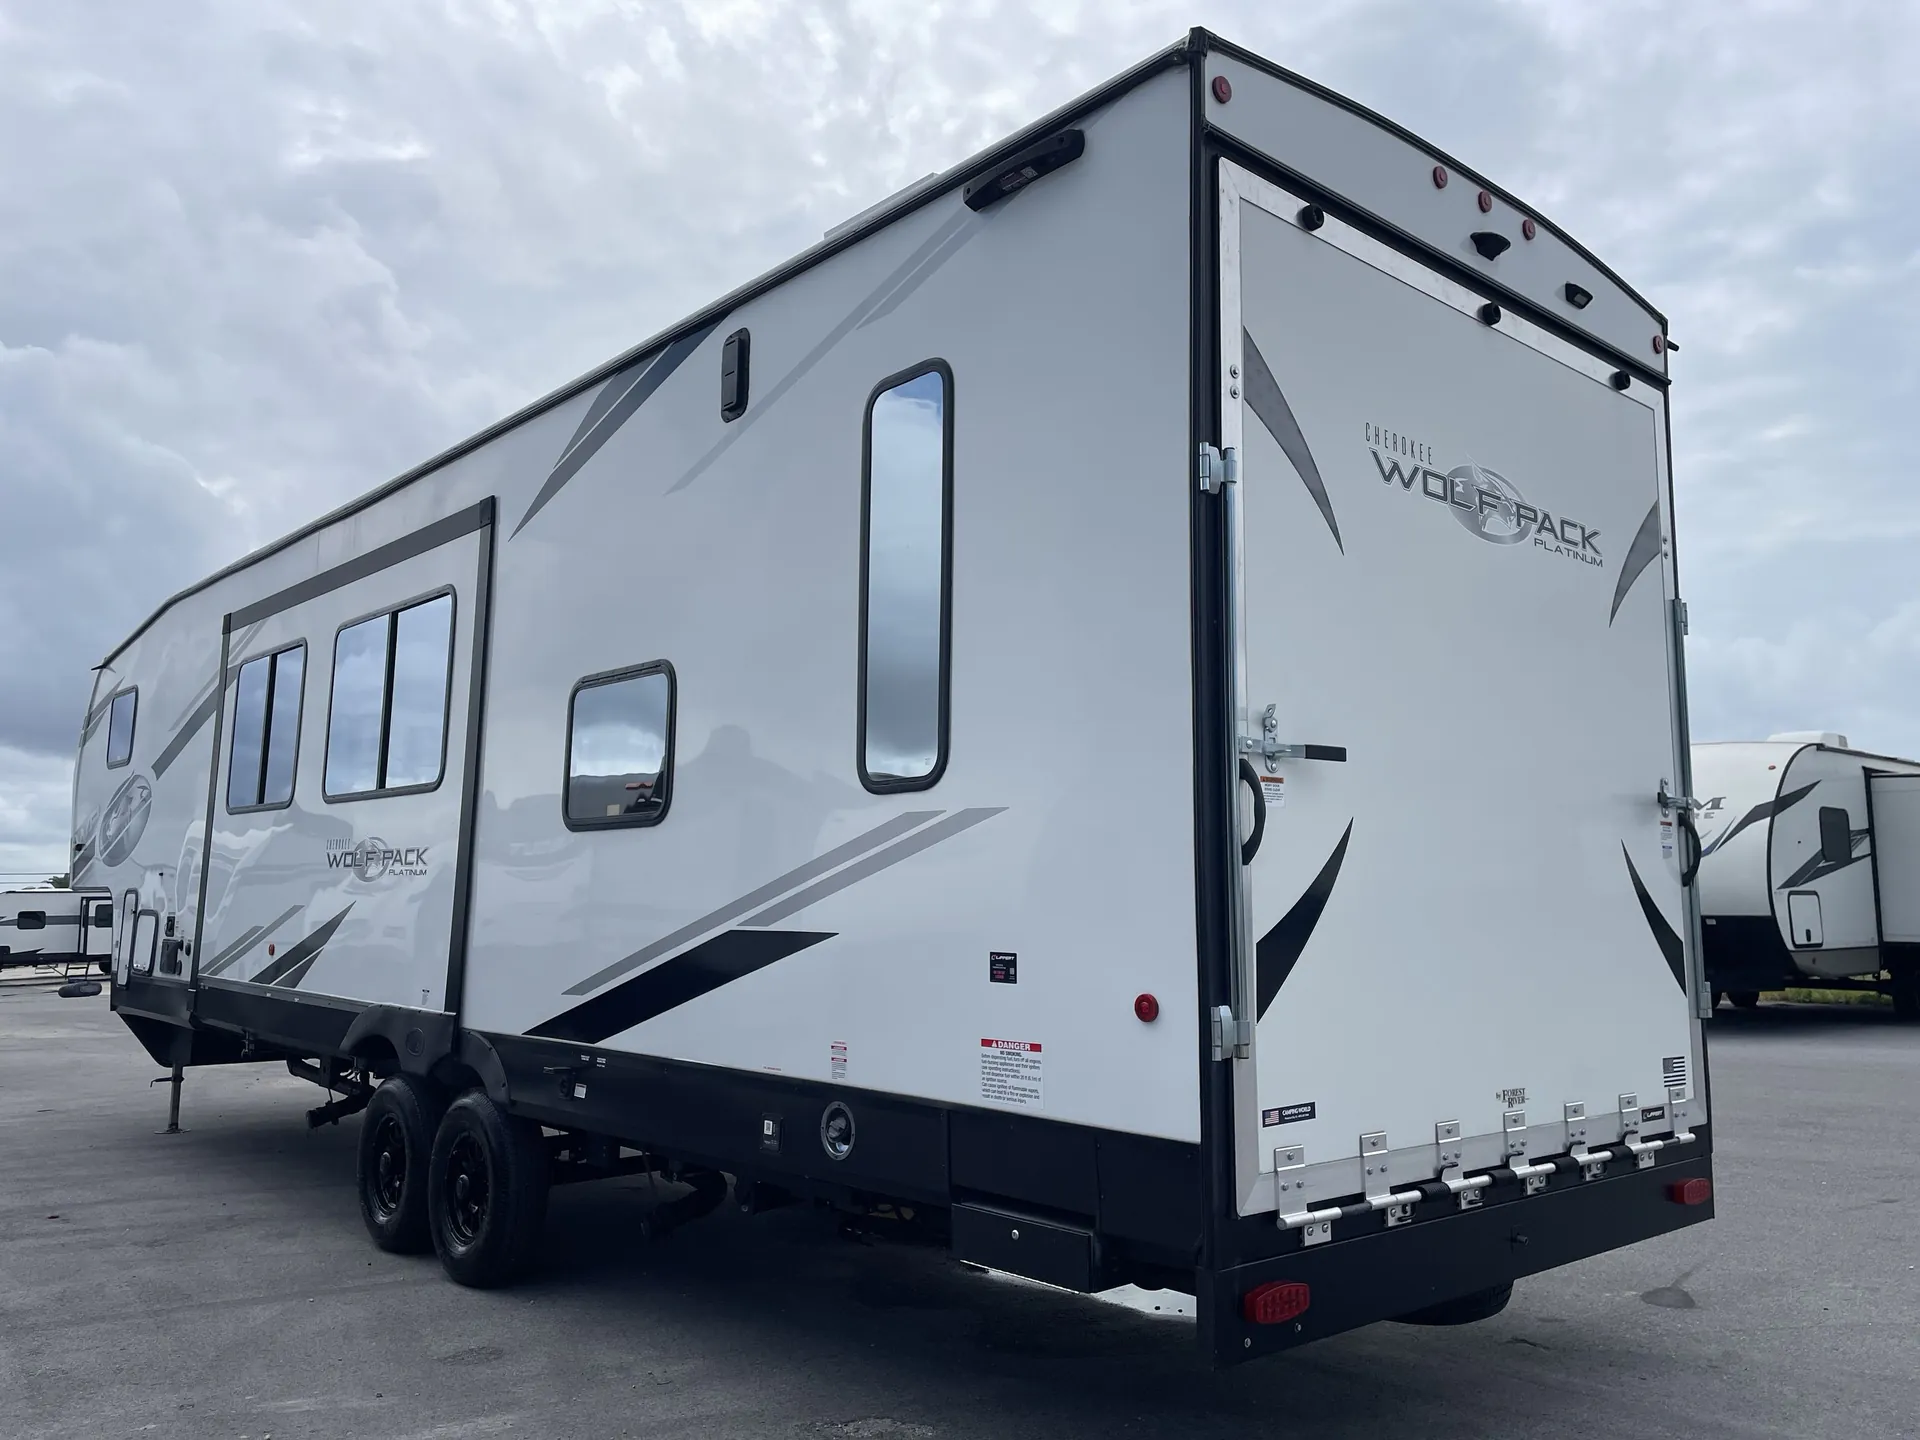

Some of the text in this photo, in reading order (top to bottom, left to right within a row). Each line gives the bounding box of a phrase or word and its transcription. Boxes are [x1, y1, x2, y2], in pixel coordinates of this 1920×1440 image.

[1366, 422, 1432, 465] CHEROKEE
[1369, 447, 1602, 557] WOLF PACK
[1534, 537, 1603, 567] PLATINUM
[326, 847, 429, 868] WOLF PACK
[998, 1041, 1031, 1051] DANGER
[1502, 1088, 1526, 1101] FOREST
[1507, 1096, 1526, 1108] RIVER
